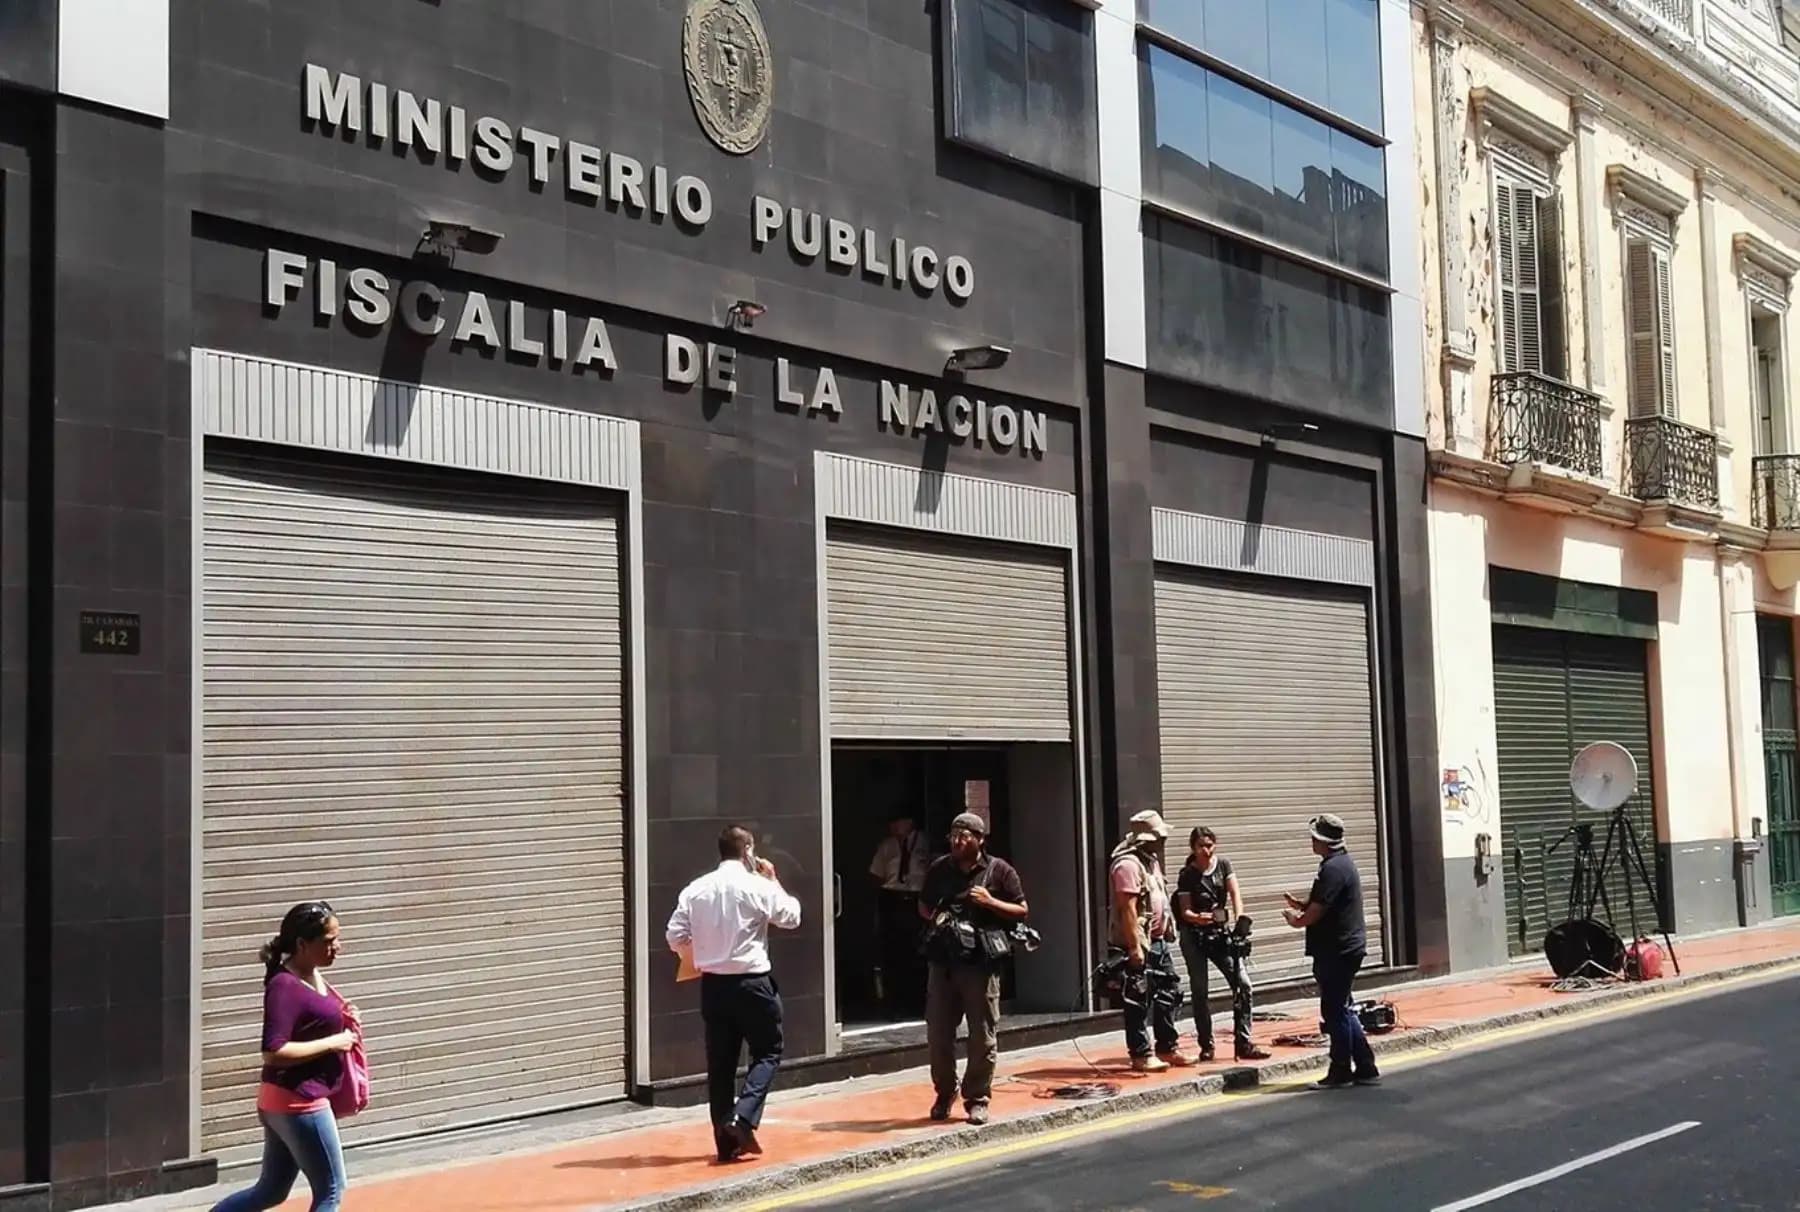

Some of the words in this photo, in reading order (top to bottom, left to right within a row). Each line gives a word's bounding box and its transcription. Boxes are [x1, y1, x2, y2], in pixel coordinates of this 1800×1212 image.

[305, 62, 713, 225] MINISTERIO
[754, 195, 975, 299] PUBLICO
[266, 247, 619, 370] FISCALIA
[666, 332, 737, 394] DE
[777, 357, 844, 414] LA
[880, 379, 1048, 452] NACION
[93, 629, 128, 646] 442
